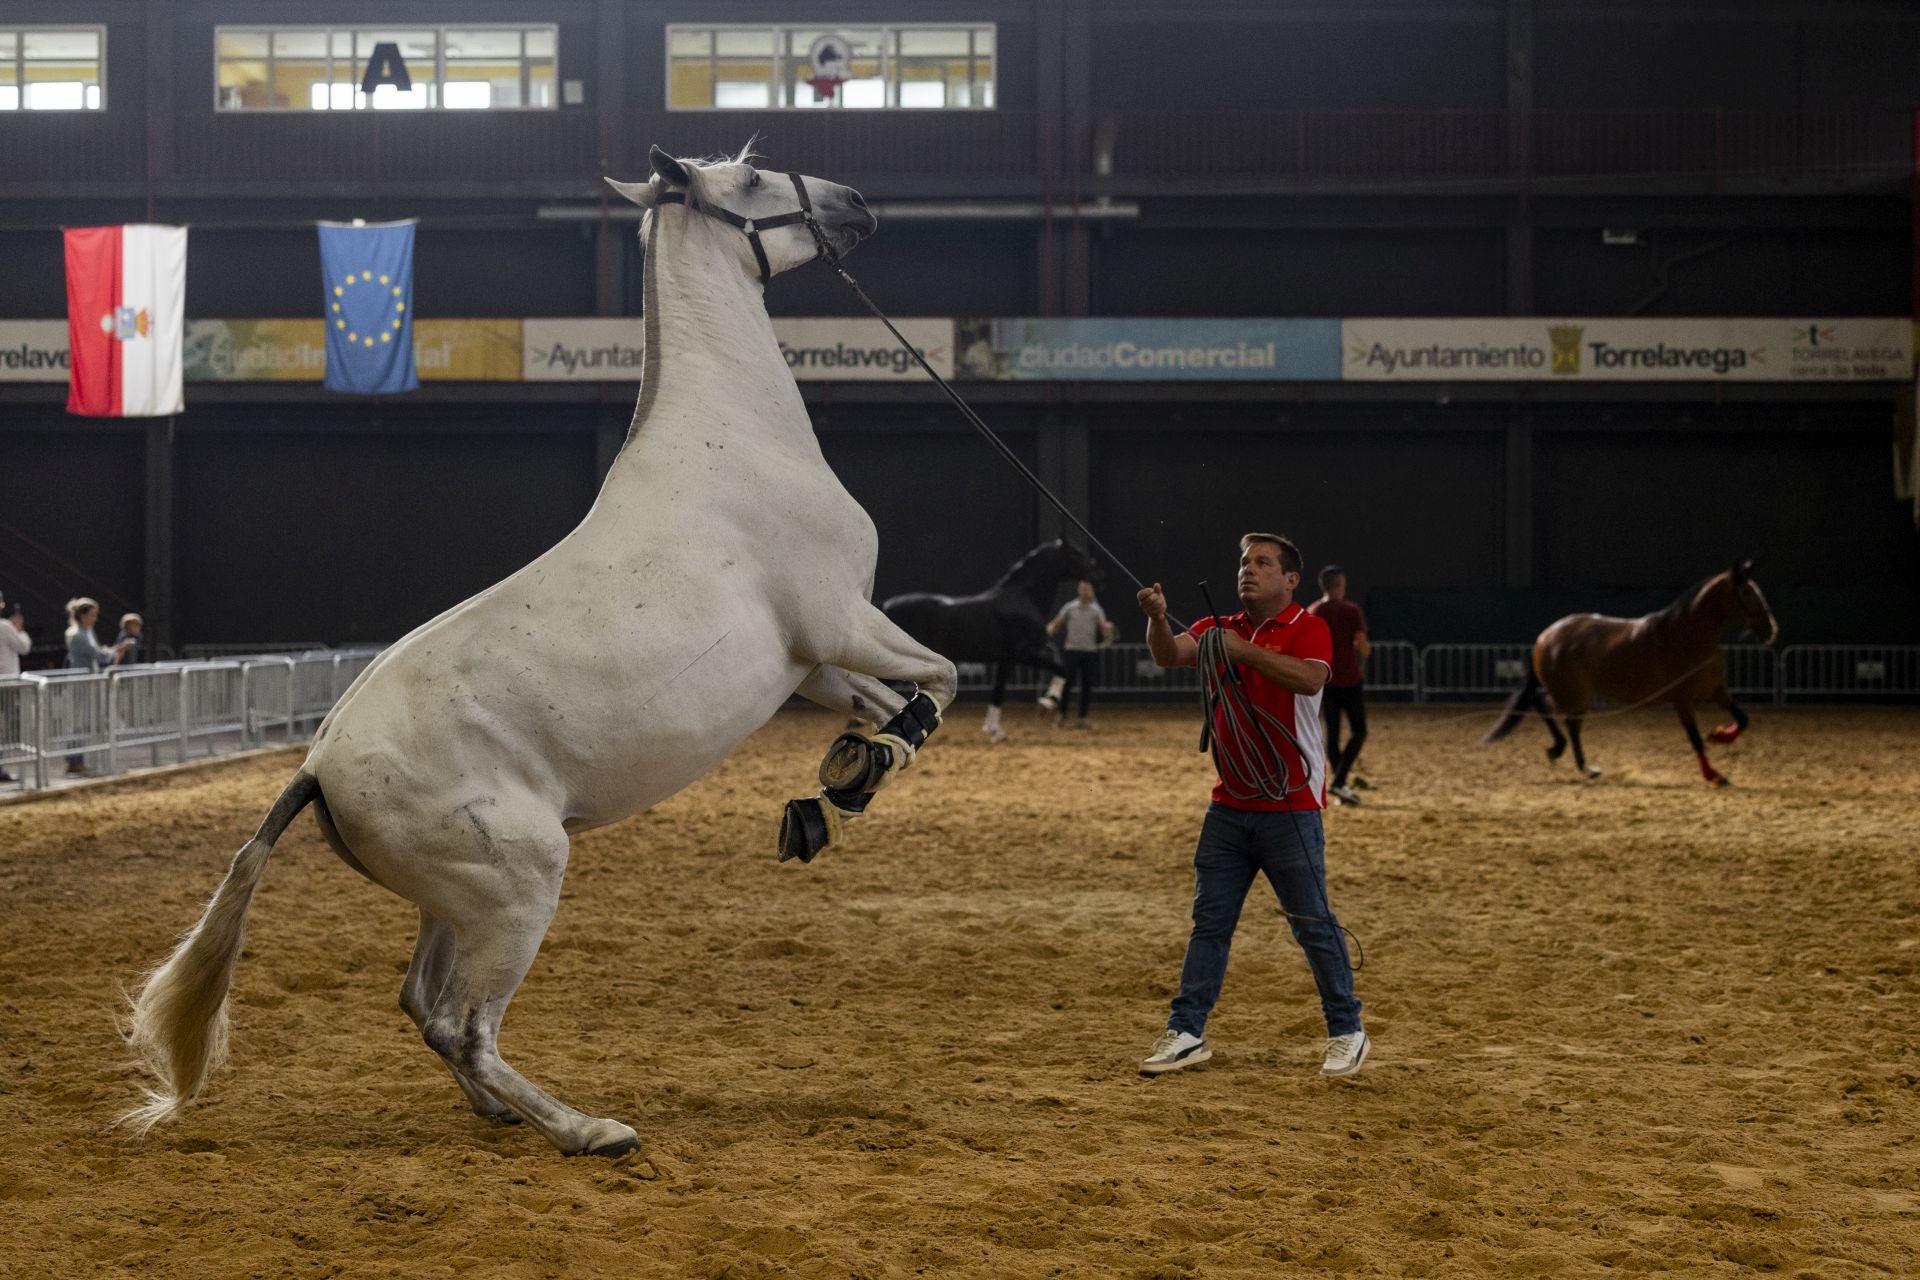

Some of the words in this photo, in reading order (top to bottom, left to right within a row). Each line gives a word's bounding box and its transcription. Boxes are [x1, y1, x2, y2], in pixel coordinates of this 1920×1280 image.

[361, 41, 412, 92] A
[1367, 342, 1546, 373] Ayuntamiento
[1588, 342, 1748, 374] Torrelavega
